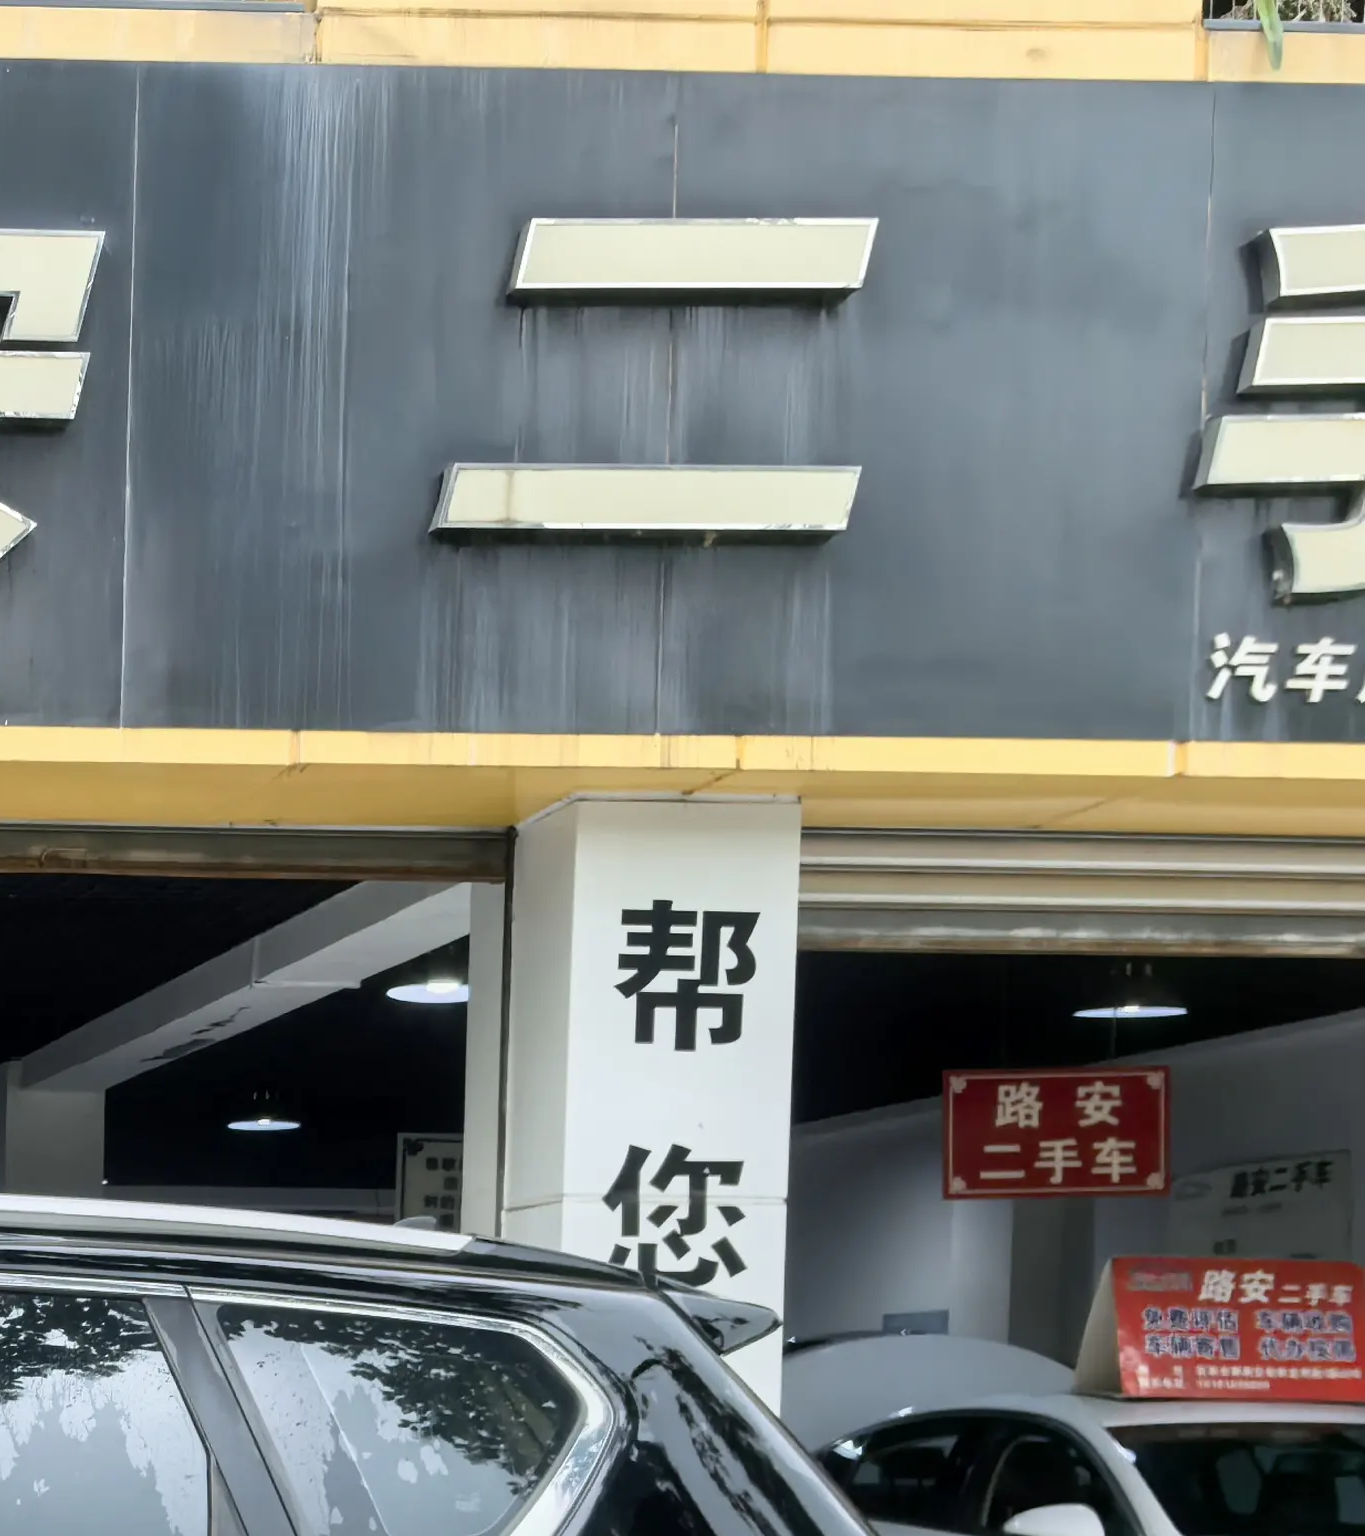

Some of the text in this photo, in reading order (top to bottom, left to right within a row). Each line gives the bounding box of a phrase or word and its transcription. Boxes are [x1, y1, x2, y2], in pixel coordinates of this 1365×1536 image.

[1206, 632, 1365, 703] 汽车
[603, 899, 761, 1288] 帮您
[994, 1080, 1123, 1129] 路安
[980, 1136, 1137, 1185] 二手车
[1198, 1269, 1354, 1306] 路安二手车
